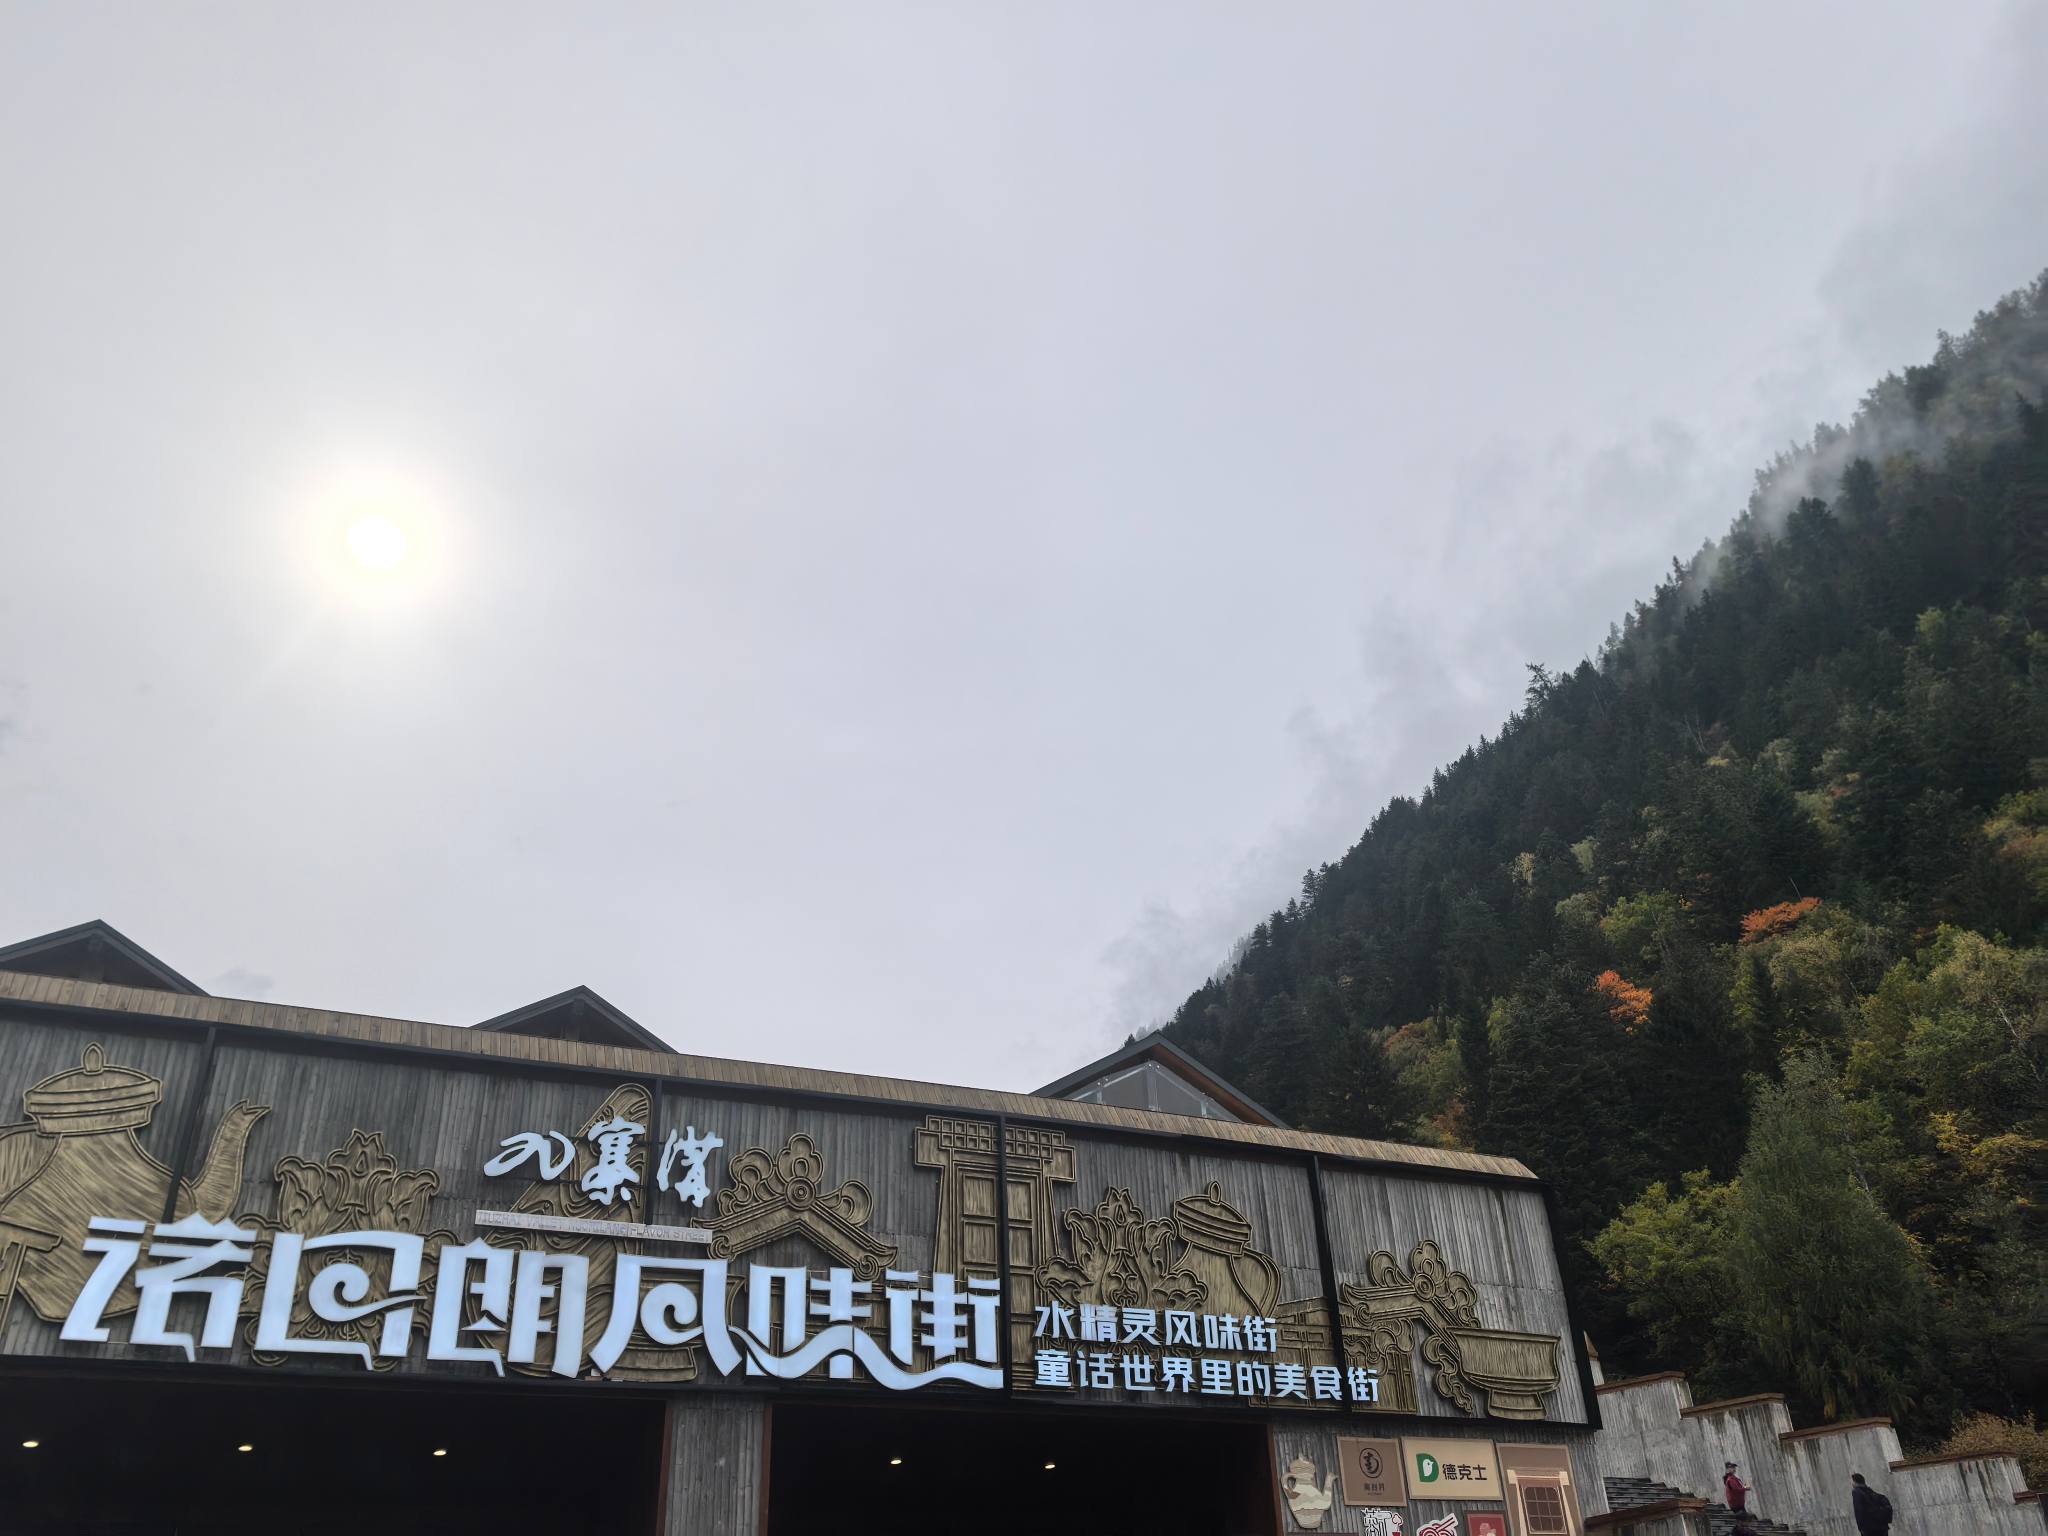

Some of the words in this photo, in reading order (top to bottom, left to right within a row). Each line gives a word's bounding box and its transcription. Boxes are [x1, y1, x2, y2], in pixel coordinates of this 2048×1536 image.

[60, 1215, 1004, 1390] 诺日朗风味街
[1034, 1300, 1277, 1352] 水精灵风味街
[1034, 1348, 1380, 1402] 童话世界里的美食街
[1442, 1463, 1488, 1481] 德克士
